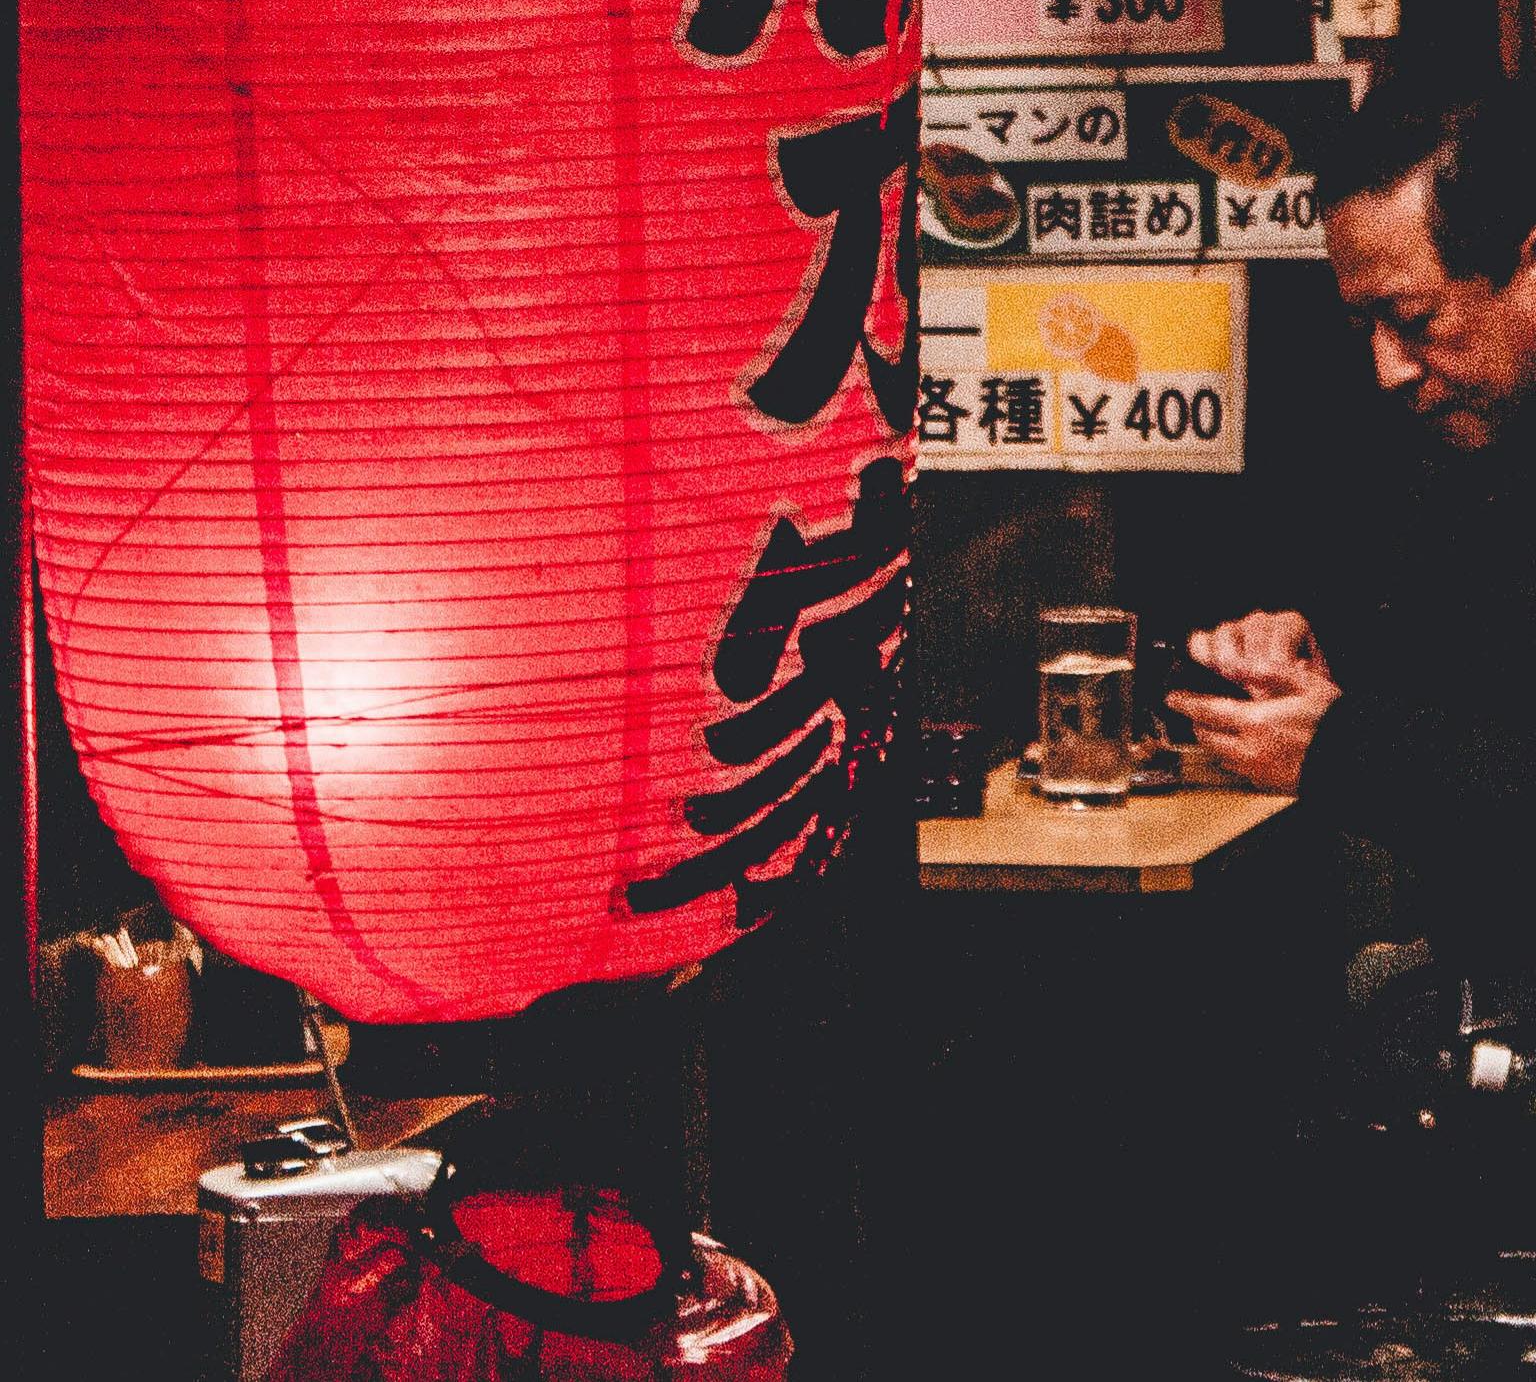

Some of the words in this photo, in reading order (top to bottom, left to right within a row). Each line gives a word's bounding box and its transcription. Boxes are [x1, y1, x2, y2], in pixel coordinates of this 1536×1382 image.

[1034, 191, 1195, 242] 肉詰め
[917, 377, 1048, 446] 各種
[1068, 387, 1224, 441] ¥400
